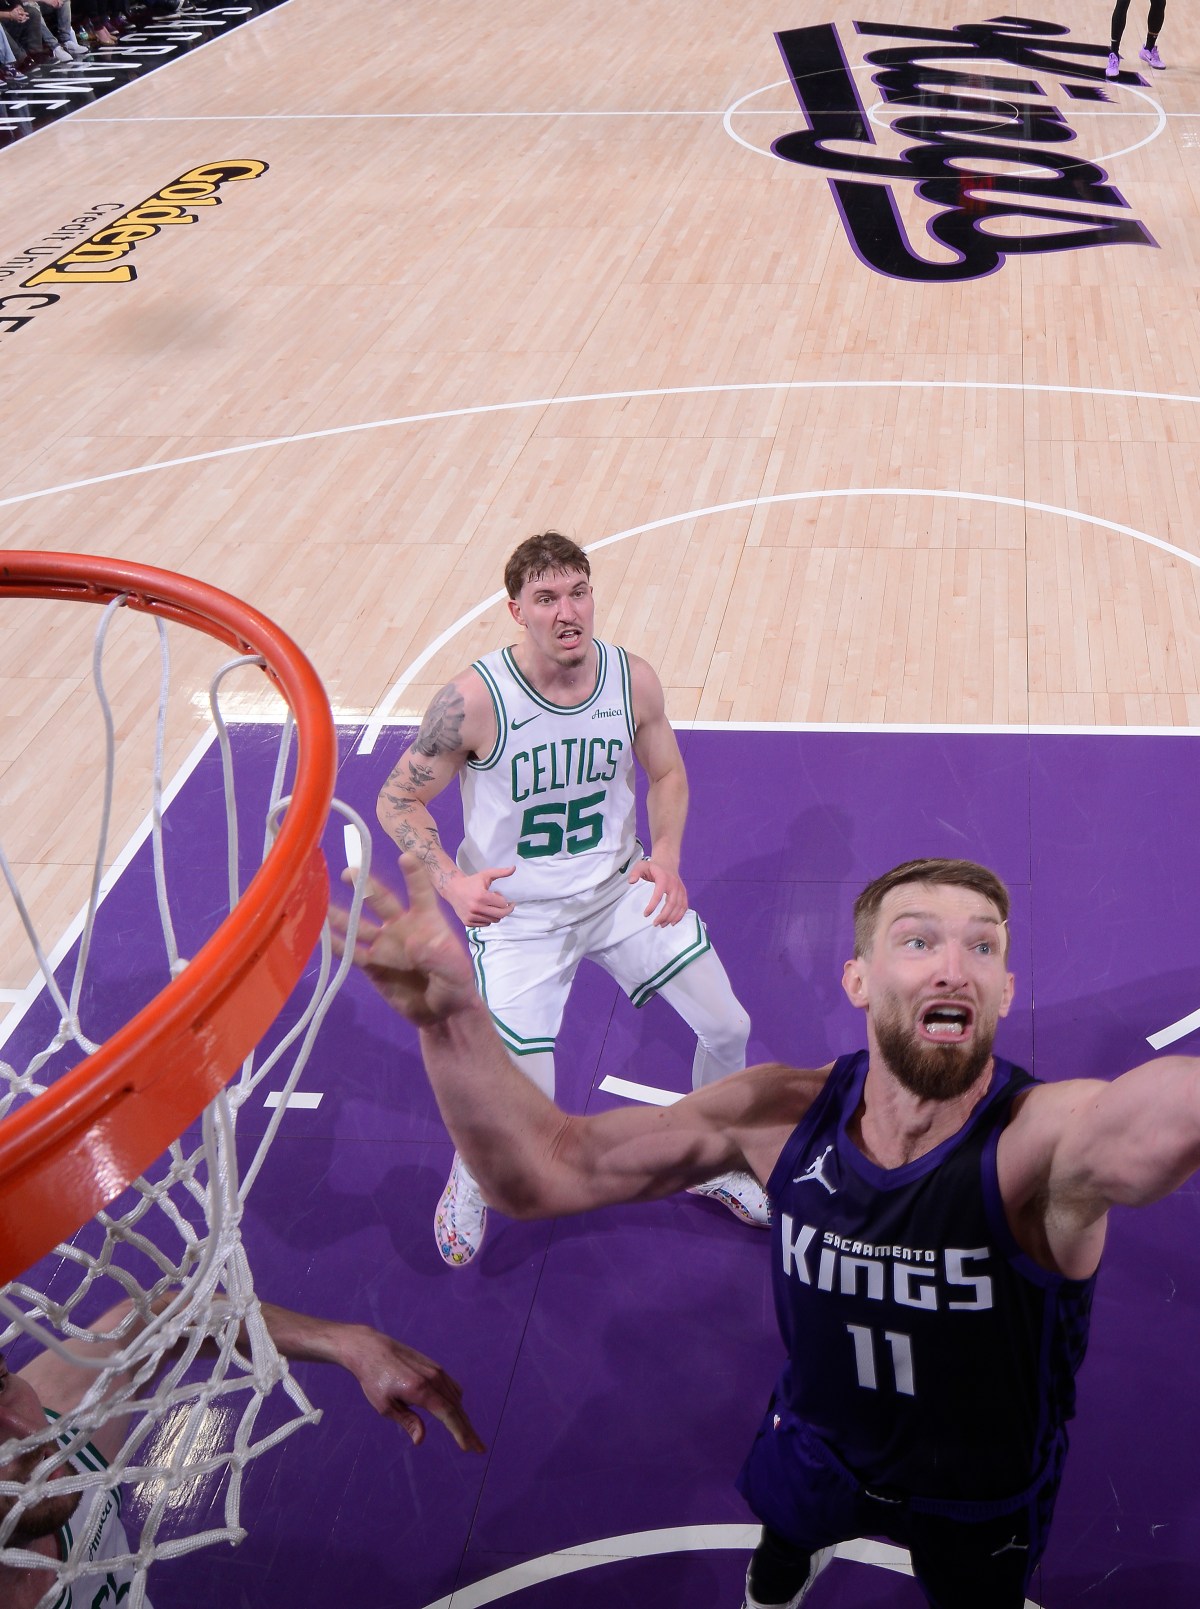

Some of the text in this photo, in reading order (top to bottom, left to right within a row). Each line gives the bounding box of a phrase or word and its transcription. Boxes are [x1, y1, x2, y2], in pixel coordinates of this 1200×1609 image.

[770, 16, 1162, 283] Kings
[0, 203, 125, 282] Credit Unio
[591, 707, 623, 720] Amica
[511, 738, 623, 803] CELTICS
[516, 790, 607, 860] 55
[823, 1231, 935, 1262] SACRAMENTO
[846, 1324, 915, 1396] 11
